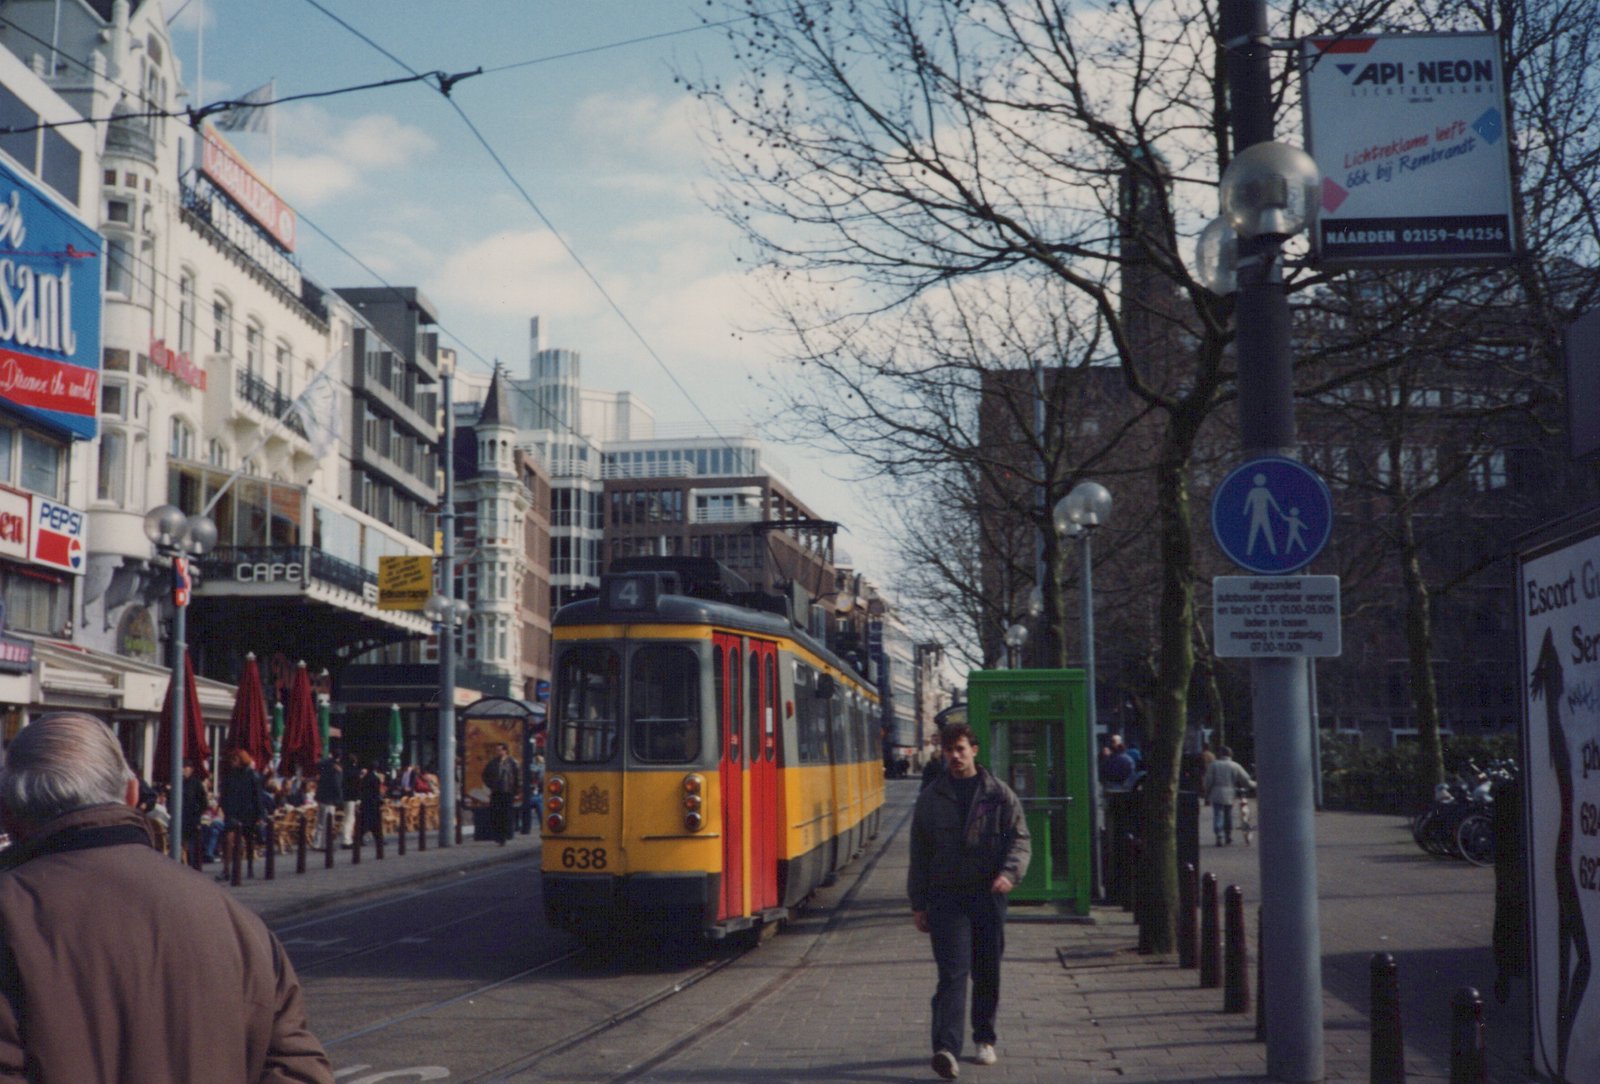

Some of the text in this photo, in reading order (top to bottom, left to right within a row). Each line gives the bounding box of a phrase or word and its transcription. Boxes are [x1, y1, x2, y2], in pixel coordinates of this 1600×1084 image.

[1344, 119, 1467, 169] Lichtreklame leeft
[1376, 161, 1393, 182] bij
[1399, 136, 1477, 174] Rembrandt
[1326, 227, 1504, 244] NAARDEN 02159-44256
[50, 368, 65, 396] the
[40, 502, 83, 536] PEPSI
[236, 562, 302, 582] CAFE
[618, 581, 639, 605] 4
[1527, 570, 1577, 616] Escort
[562, 847, 607, 870] 638
